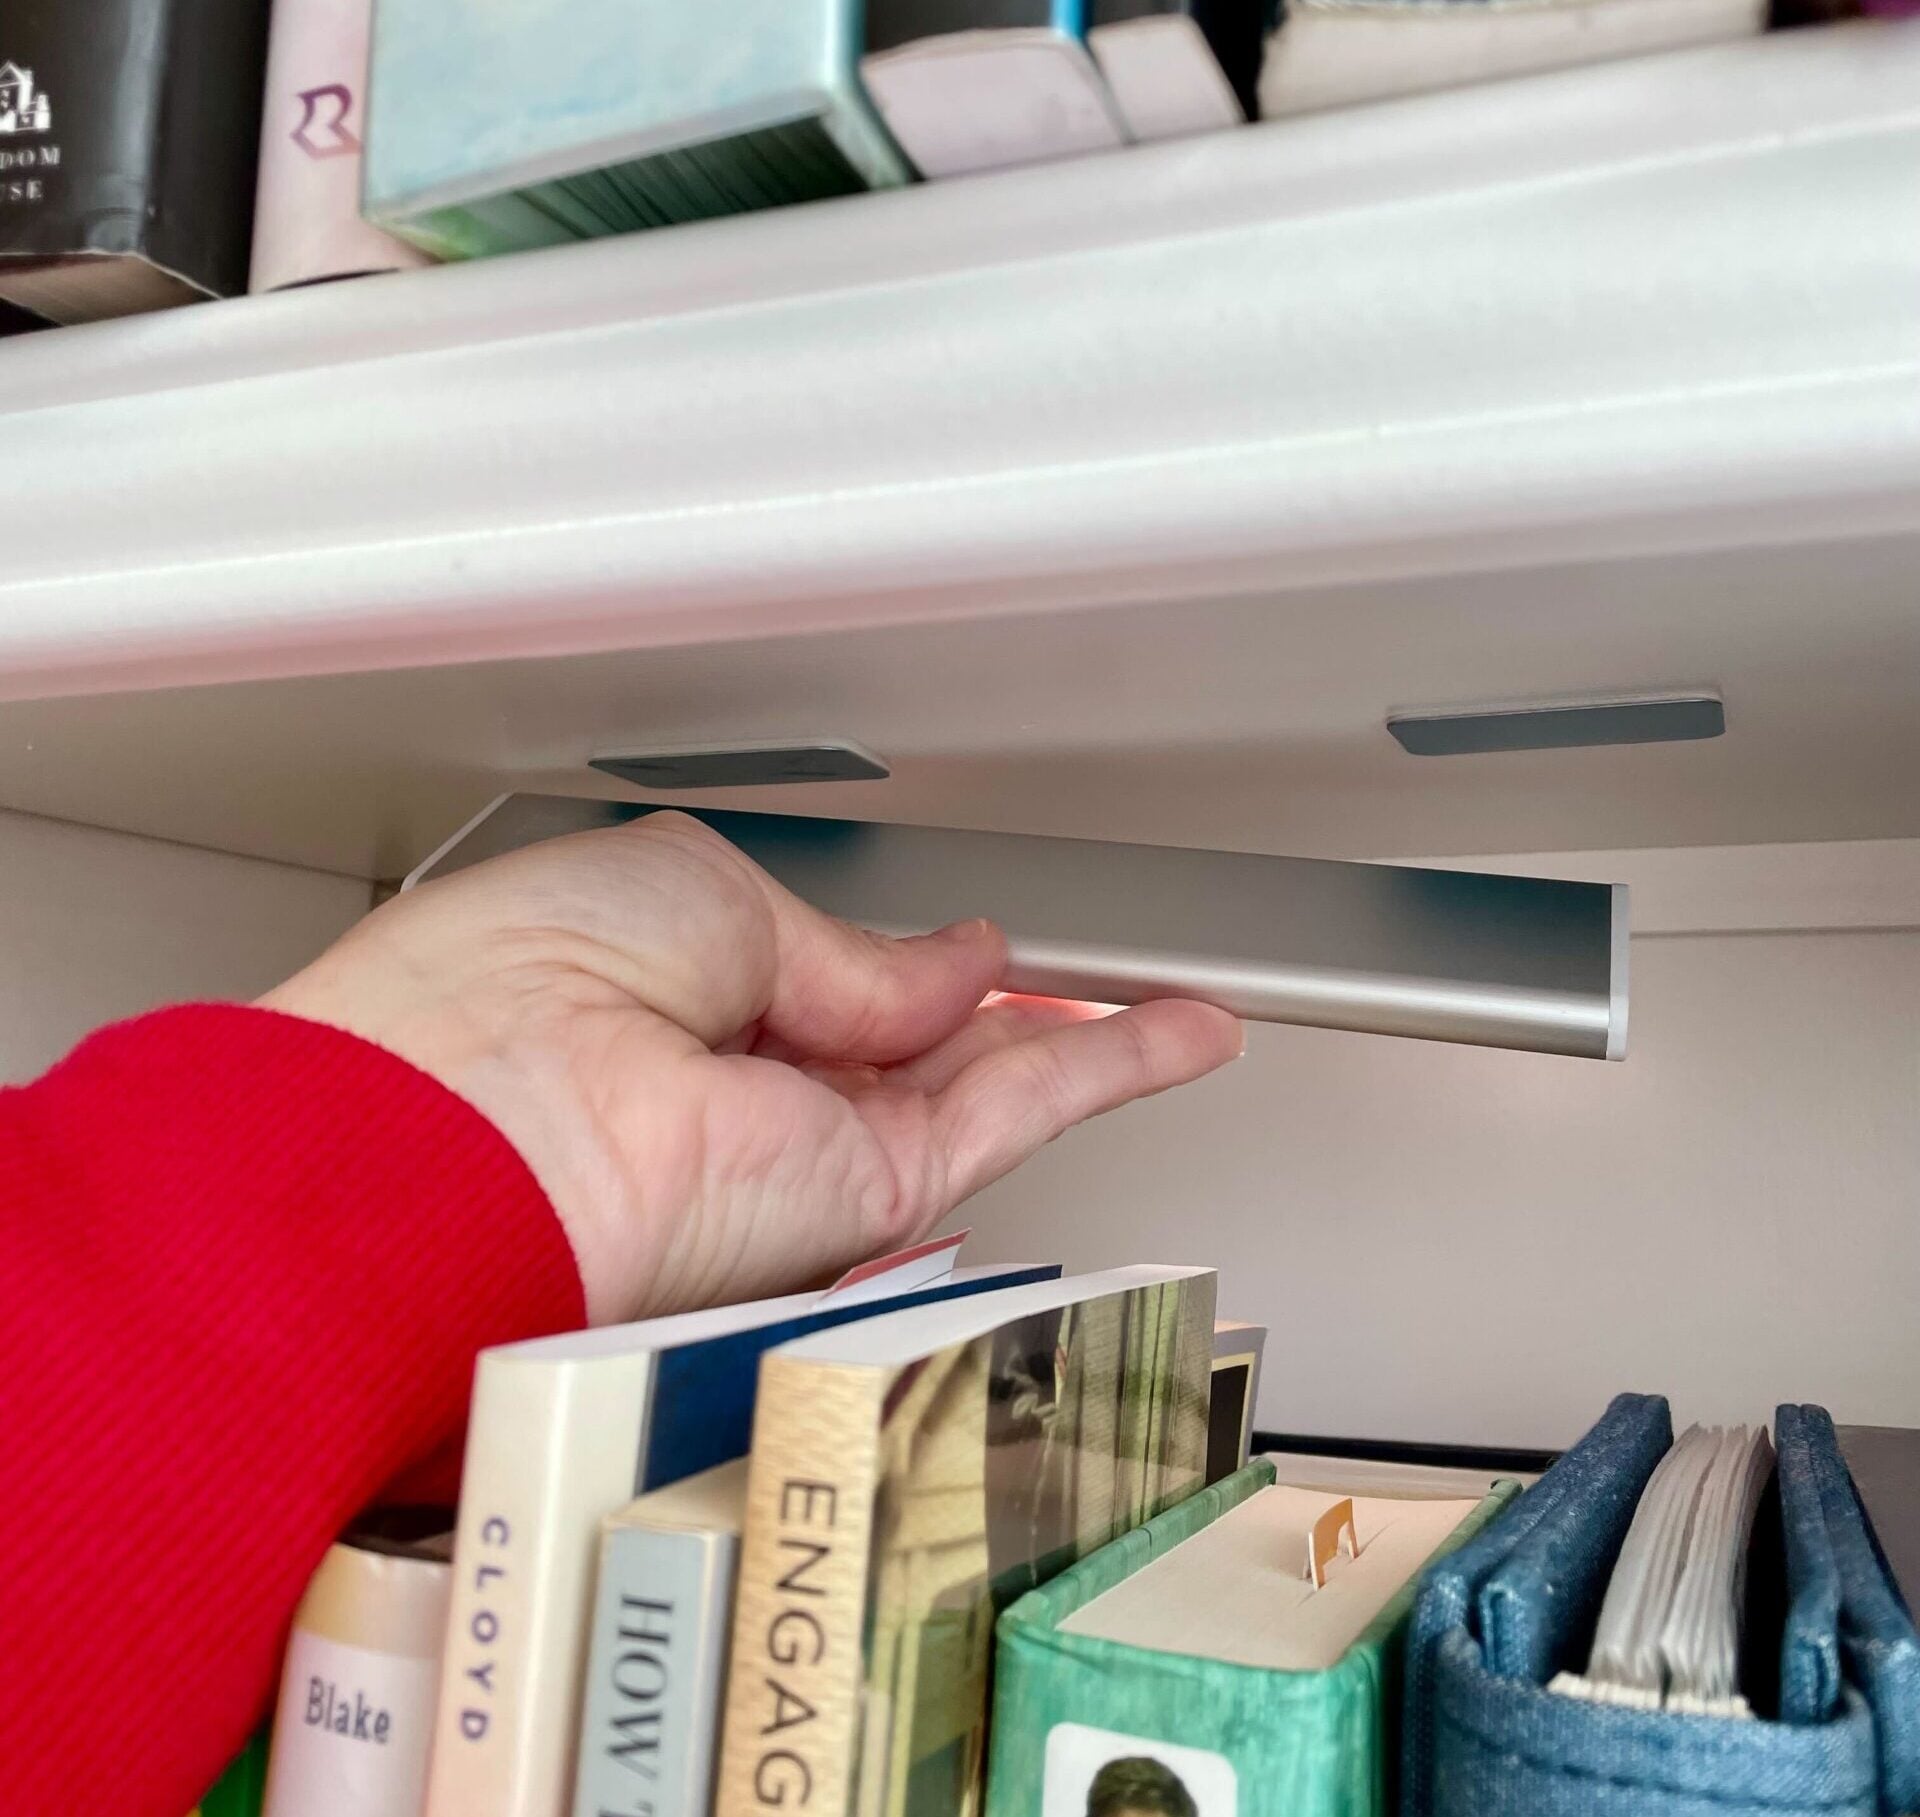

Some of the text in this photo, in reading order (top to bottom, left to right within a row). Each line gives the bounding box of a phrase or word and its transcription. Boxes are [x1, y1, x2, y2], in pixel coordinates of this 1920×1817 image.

[0, 180, 43, 202] SE
[459, 1517, 511, 1742] CLOYD
[606, 1594, 674, 1781] HOW
[304, 1675, 391, 1746] Blake
